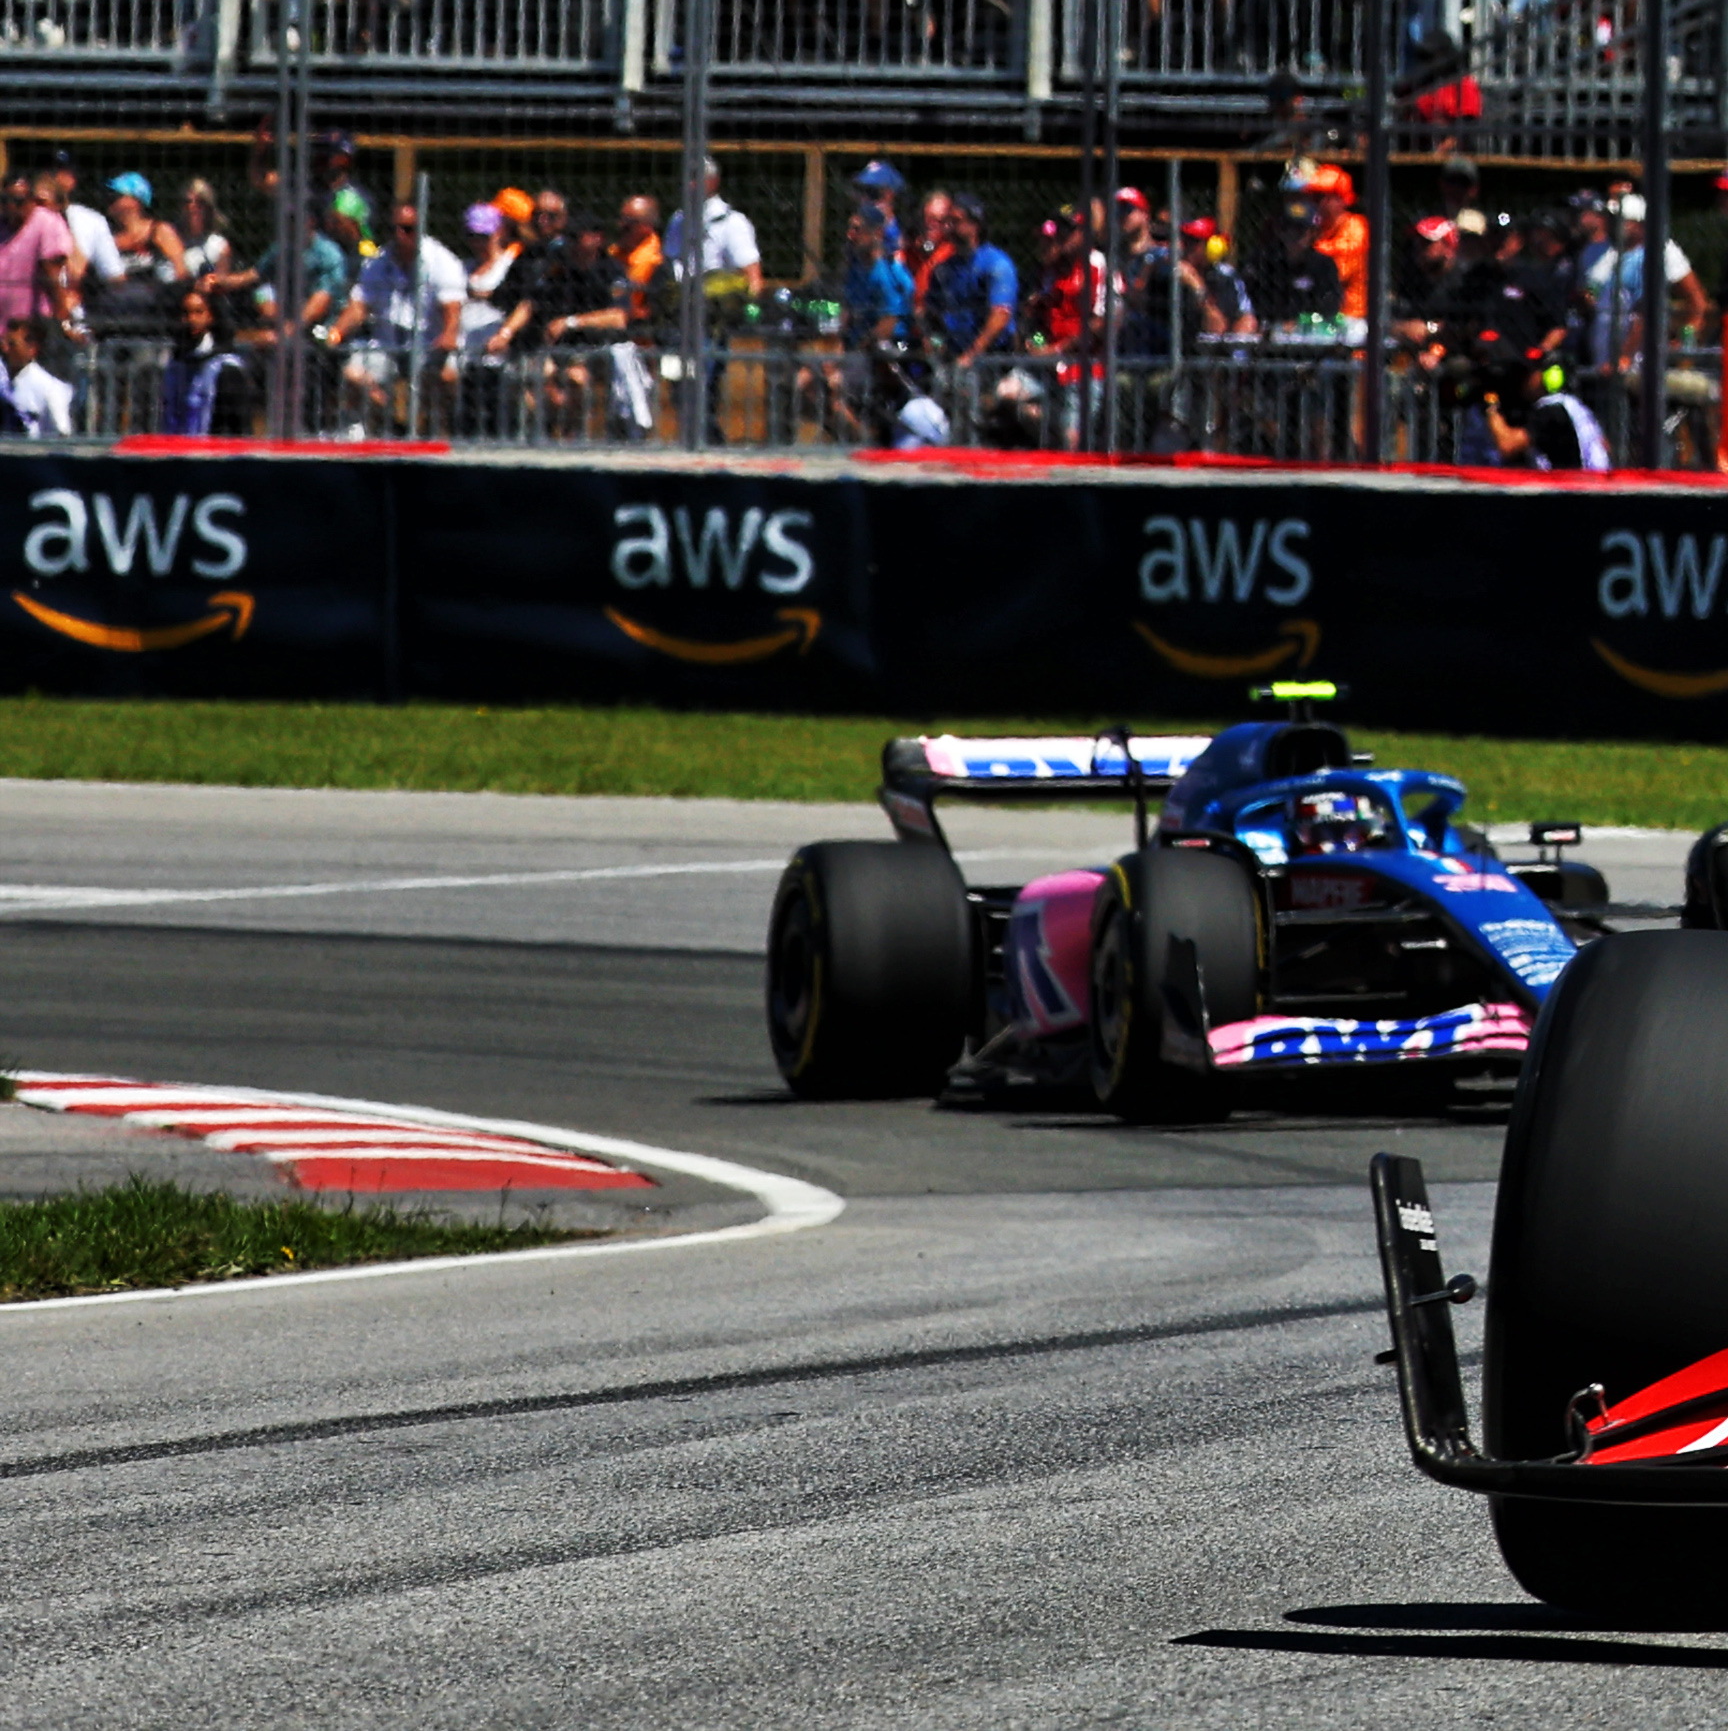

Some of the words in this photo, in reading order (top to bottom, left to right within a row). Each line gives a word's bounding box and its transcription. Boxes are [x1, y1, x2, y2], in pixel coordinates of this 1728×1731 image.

[23, 489, 248, 578] aws
[612, 504, 814, 593] aws
[1139, 515, 1311, 605] aws
